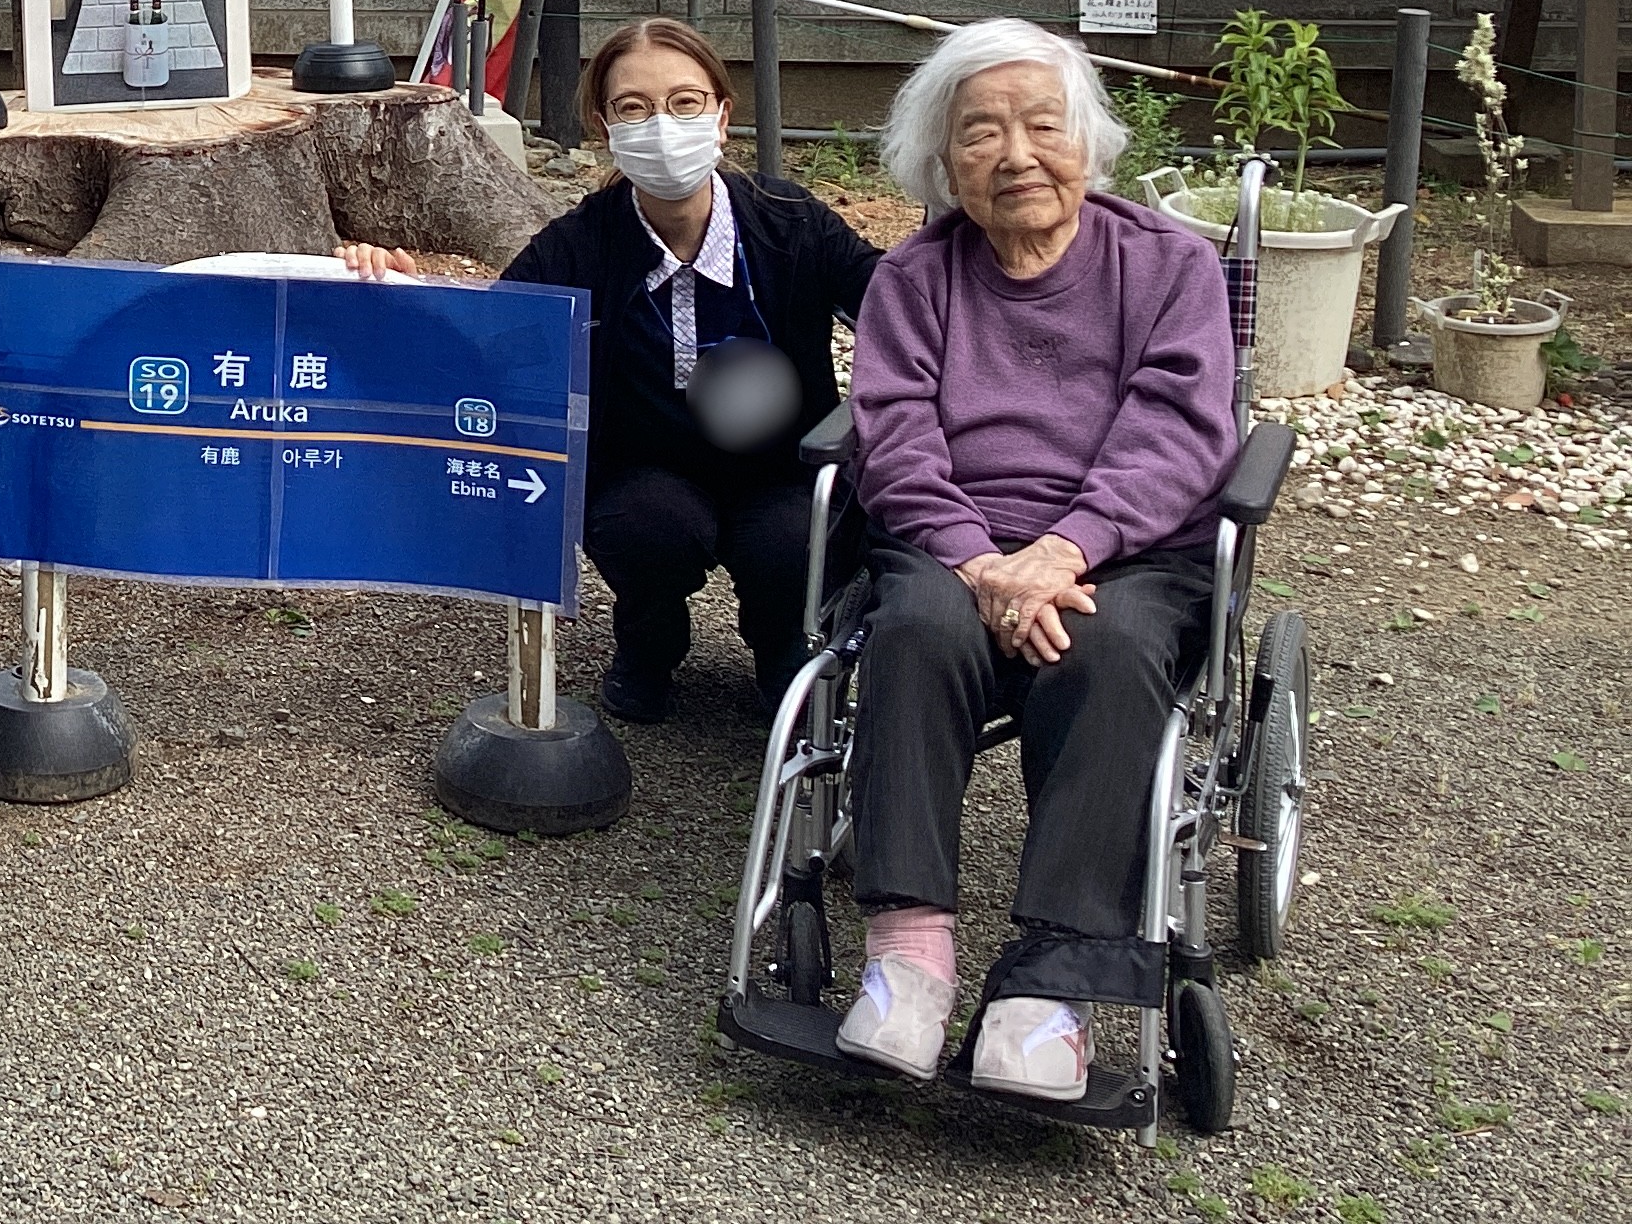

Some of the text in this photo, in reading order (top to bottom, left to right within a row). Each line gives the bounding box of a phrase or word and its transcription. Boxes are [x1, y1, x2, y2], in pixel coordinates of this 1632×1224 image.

[140, 363, 180, 379] SO
[139, 383, 179, 410] 19
[230, 398, 308, 423] Aruka
[463, 403, 489, 413] SO
[11, 413, 75, 429] SOTETSU
[463, 416, 489, 433] 18
[200, 445, 241, 466] 有鹿
[282, 448, 344, 469] 아루카
[446, 457, 501, 481] 海老名
[451, 480, 496, 499] Ebina
